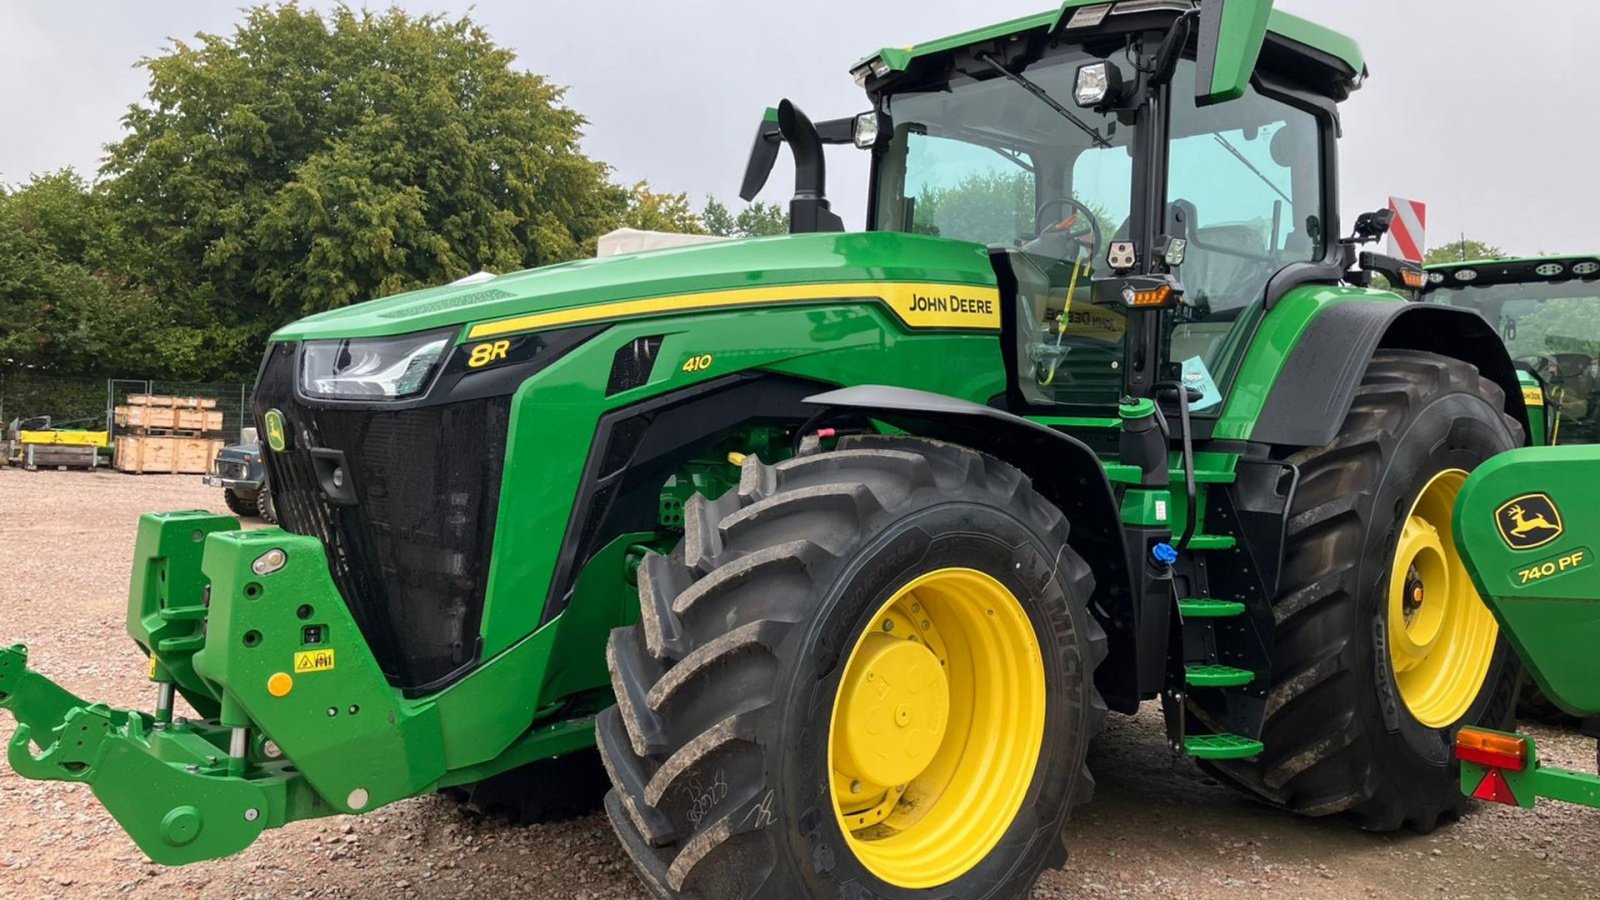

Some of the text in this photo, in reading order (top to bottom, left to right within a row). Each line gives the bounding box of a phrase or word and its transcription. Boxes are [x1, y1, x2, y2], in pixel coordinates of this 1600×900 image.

[909, 293, 993, 314] JOHN DEERE
[468, 340, 510, 367] 8R
[682, 354, 712, 371] 410
[1518, 551, 1583, 584] 740 PF
